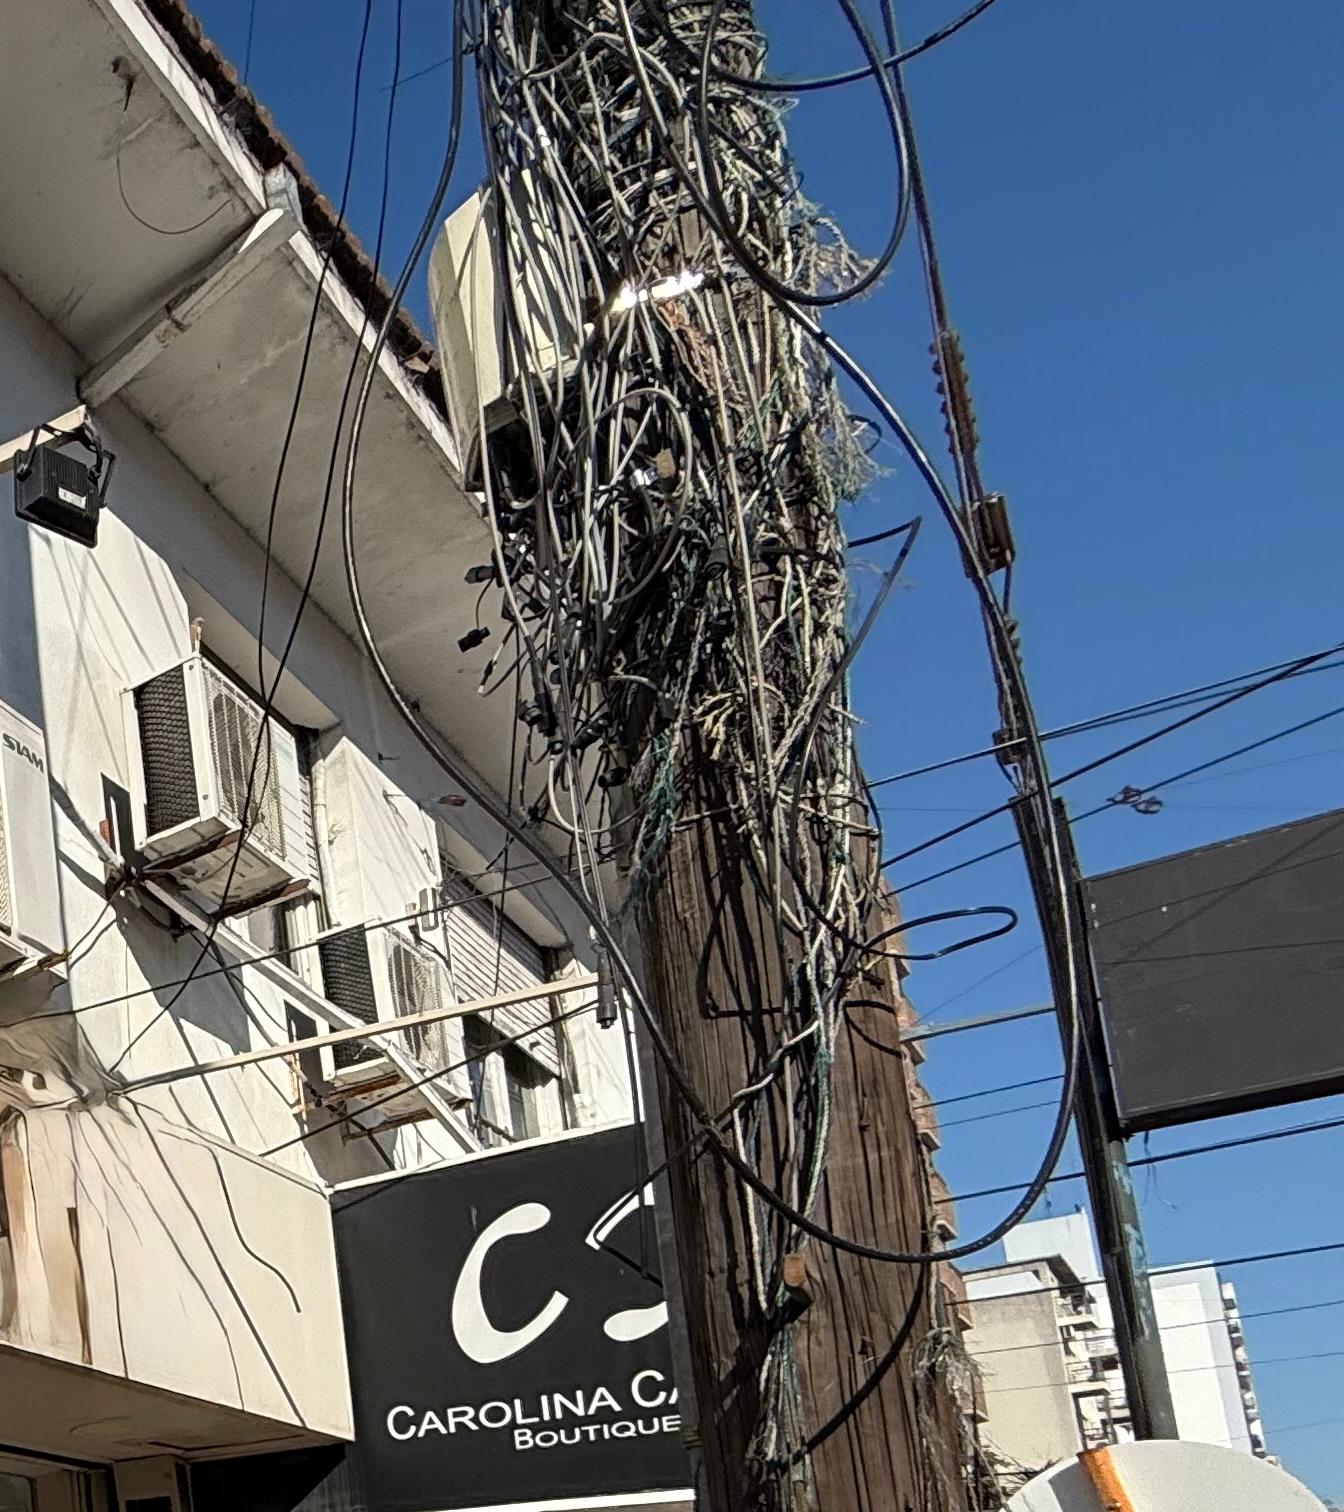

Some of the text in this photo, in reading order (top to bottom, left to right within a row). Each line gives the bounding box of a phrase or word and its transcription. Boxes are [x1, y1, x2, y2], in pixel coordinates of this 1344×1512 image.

[2, 732, 45, 774] SIAM
[386, 1369, 679, 1441] CAROLINA C
[513, 1413, 683, 1451] BOUTIQUE
